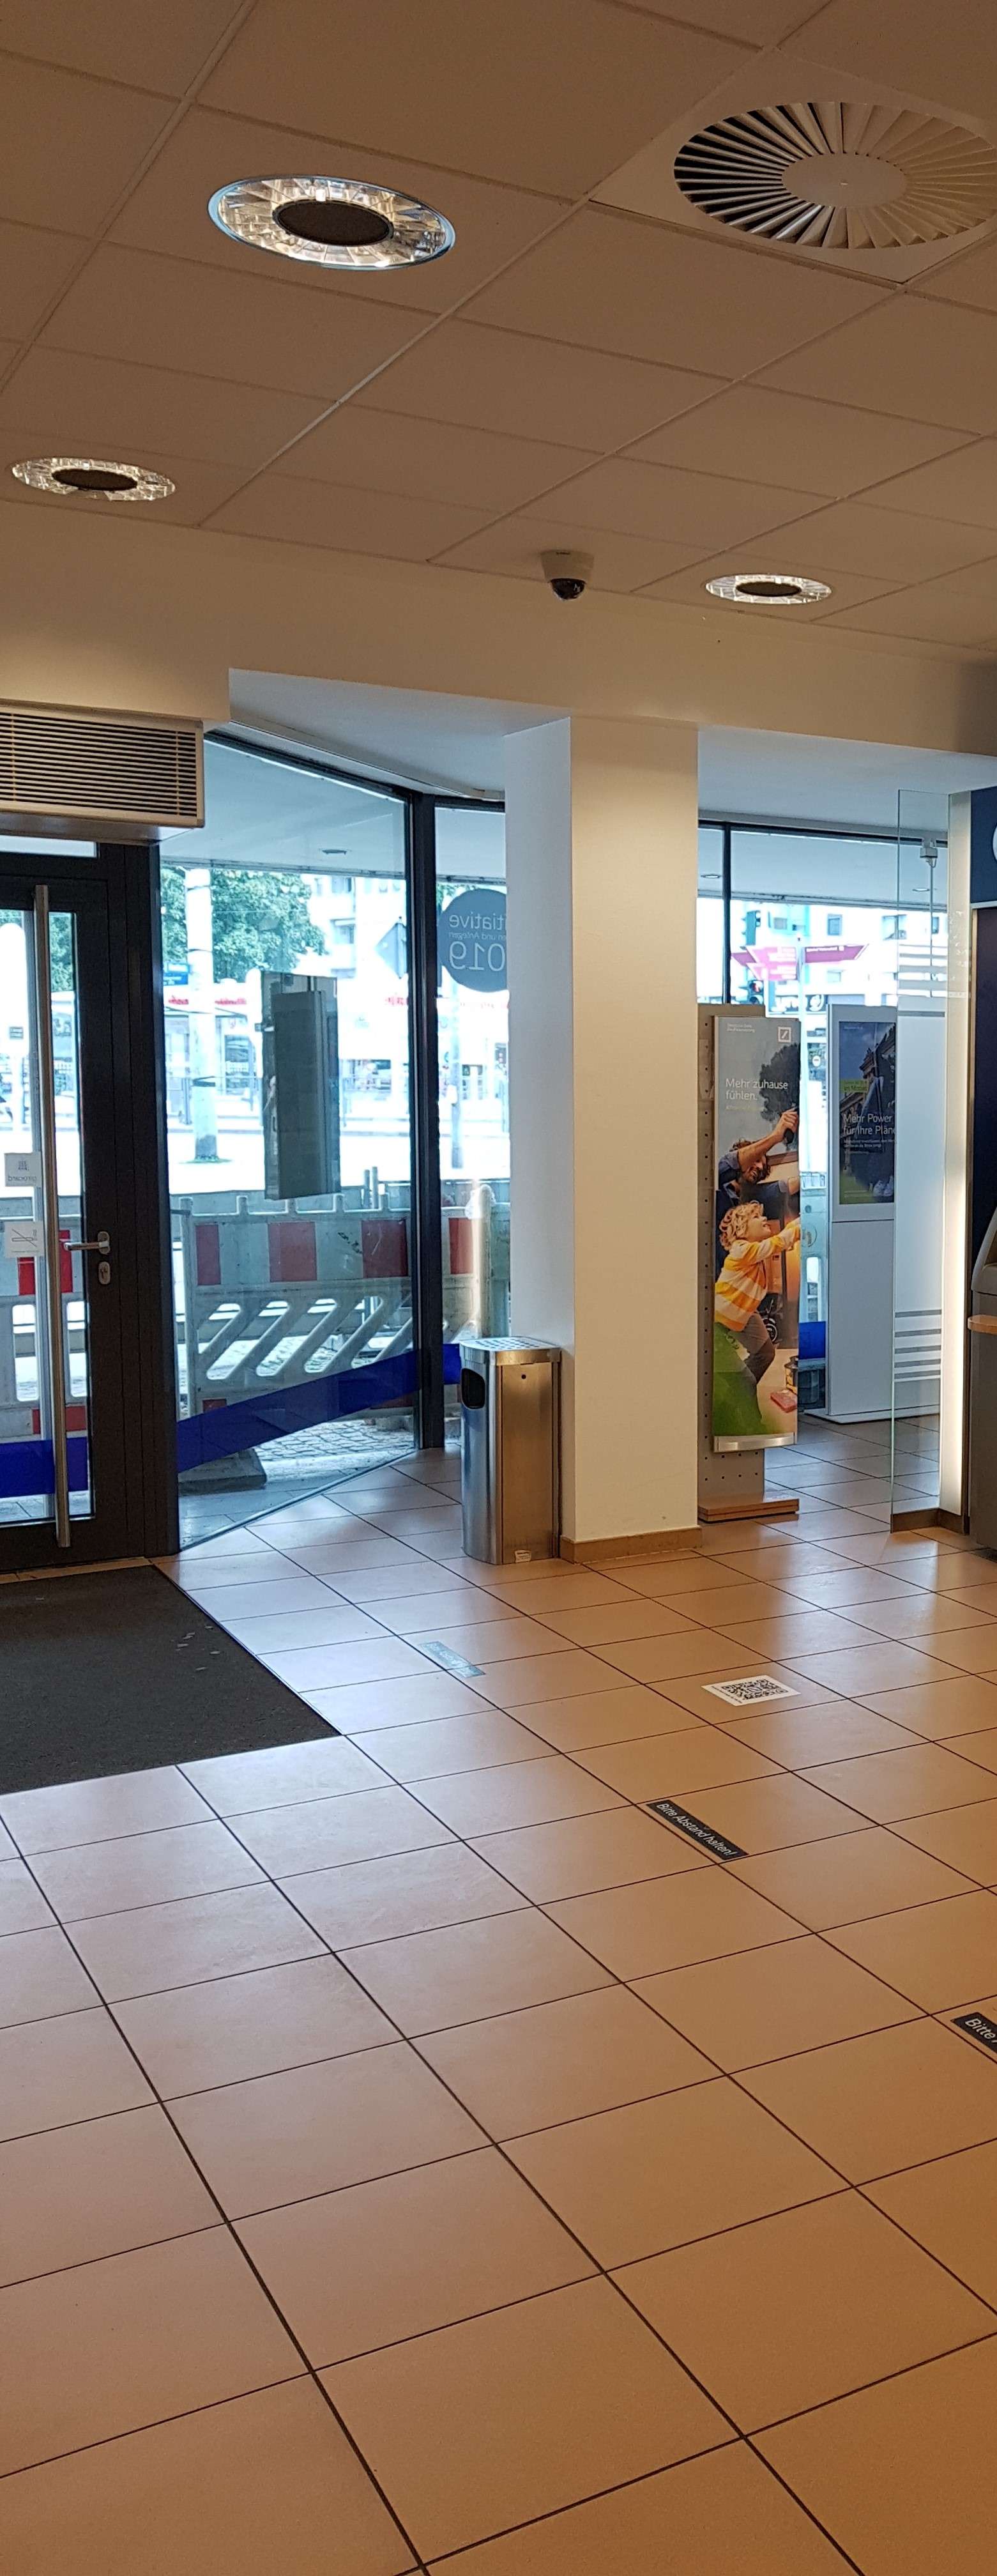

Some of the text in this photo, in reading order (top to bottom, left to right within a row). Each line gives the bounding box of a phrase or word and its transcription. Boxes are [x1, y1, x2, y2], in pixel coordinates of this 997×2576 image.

[726, 1078, 788, 1089] Mehr zuhause
[726, 1090, 757, 1100] fühlen.
[843, 1114, 892, 1123] Mehr Power
[843, 1125, 856, 1135] für
[857, 1126, 872, 1135] Ihre
[656, 1803, 738, 1856] Bitte Abstand halten!
[965, 2018, 996, 2039] Bitte
